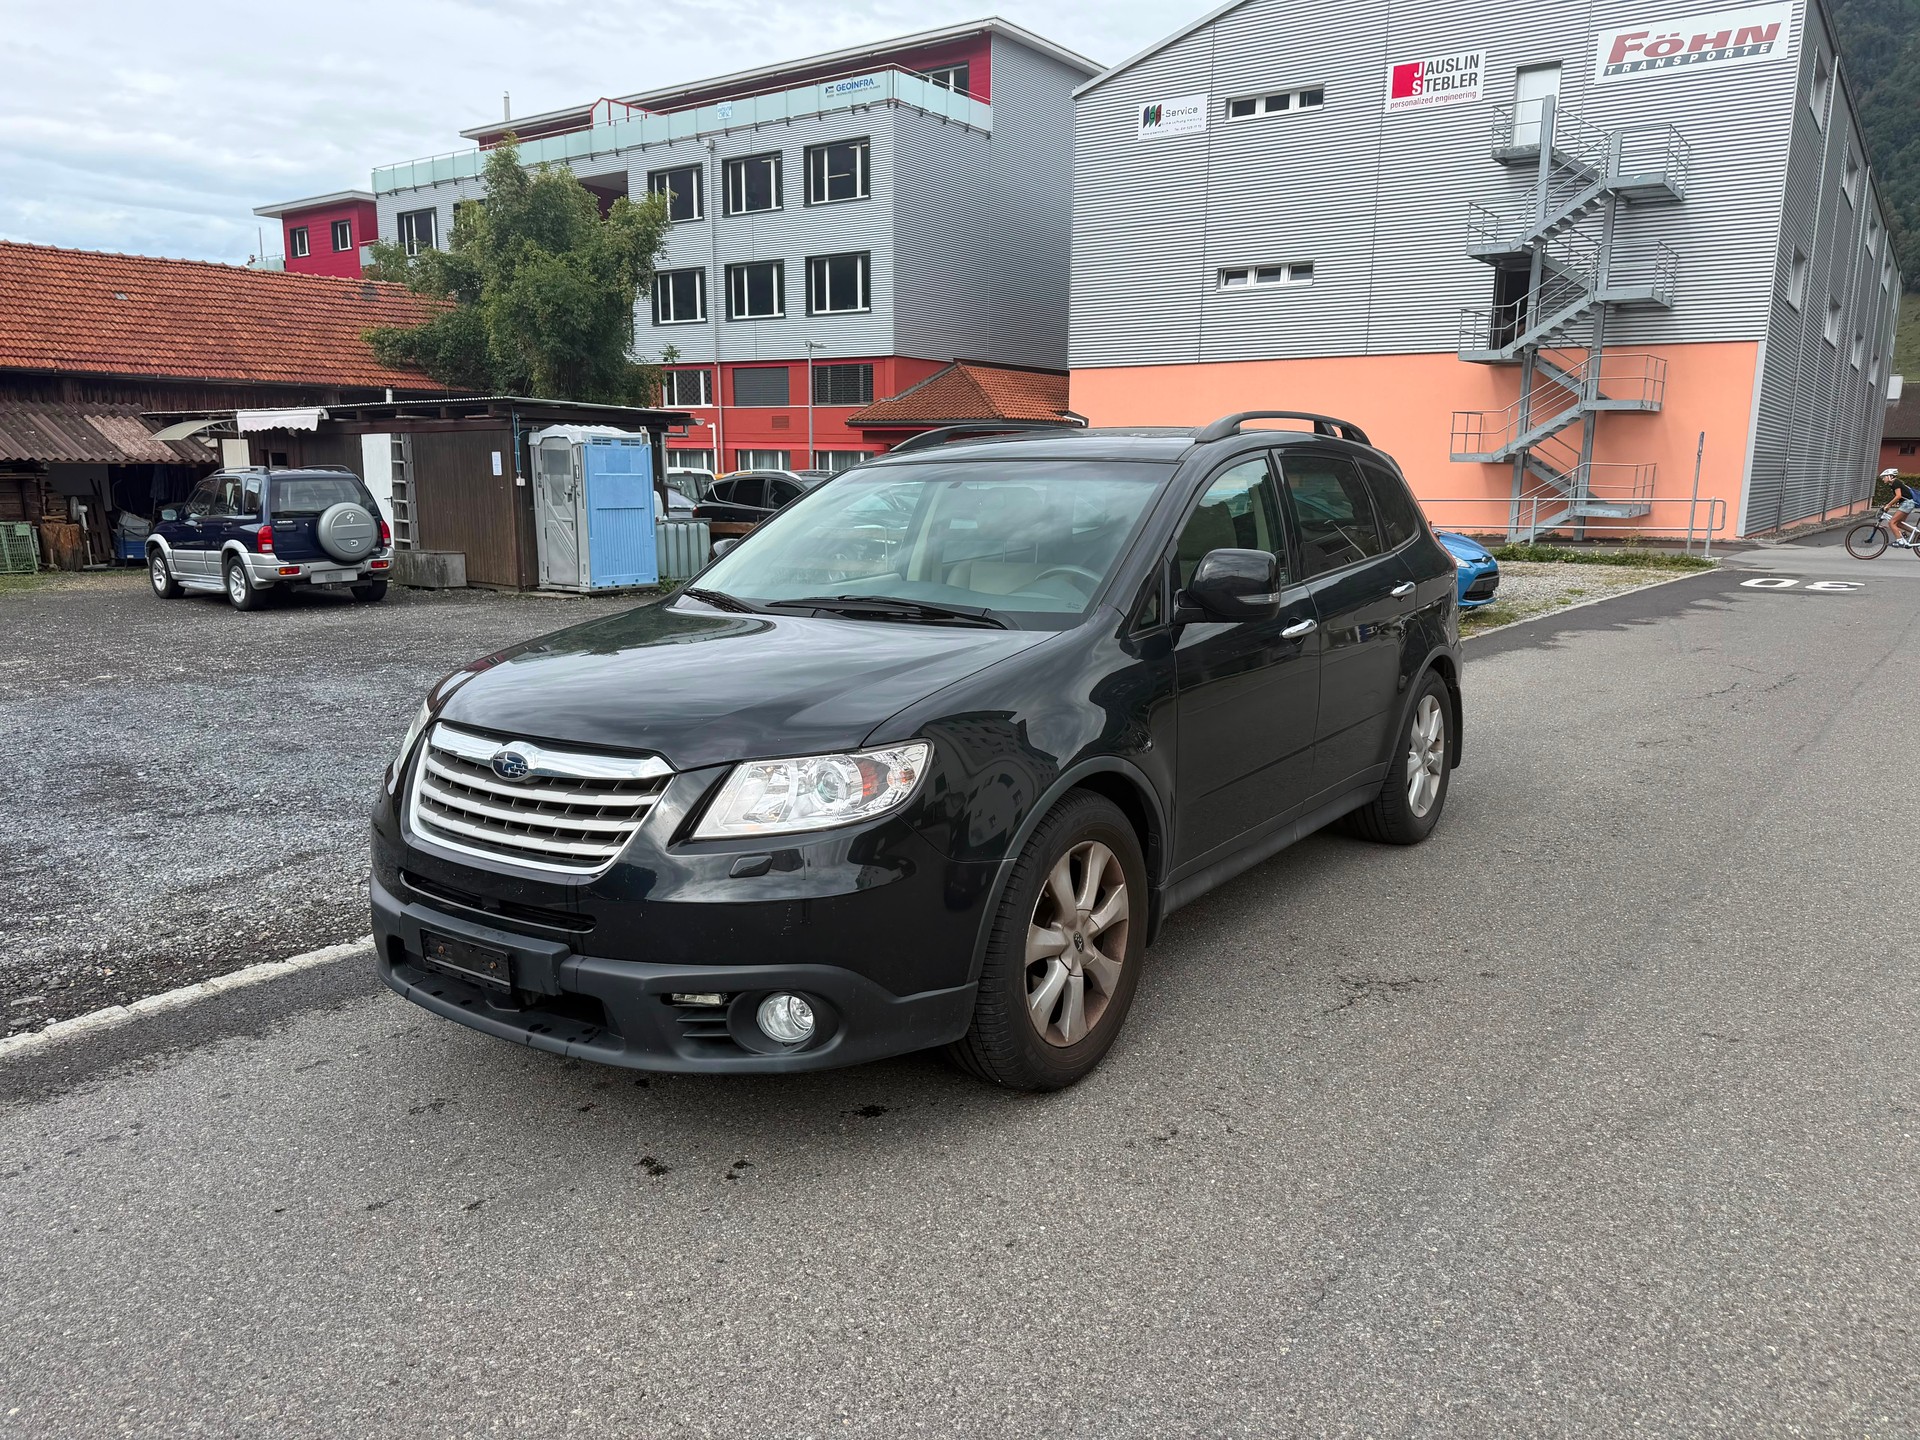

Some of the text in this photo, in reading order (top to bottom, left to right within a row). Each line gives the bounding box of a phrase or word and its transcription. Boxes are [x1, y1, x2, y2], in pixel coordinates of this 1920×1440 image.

[1607, 43, 1770, 75] TRANSPORTE
[836, 78, 874, 92] GEOINFRA
[1390, 91, 1477, 110] personalized engineering
